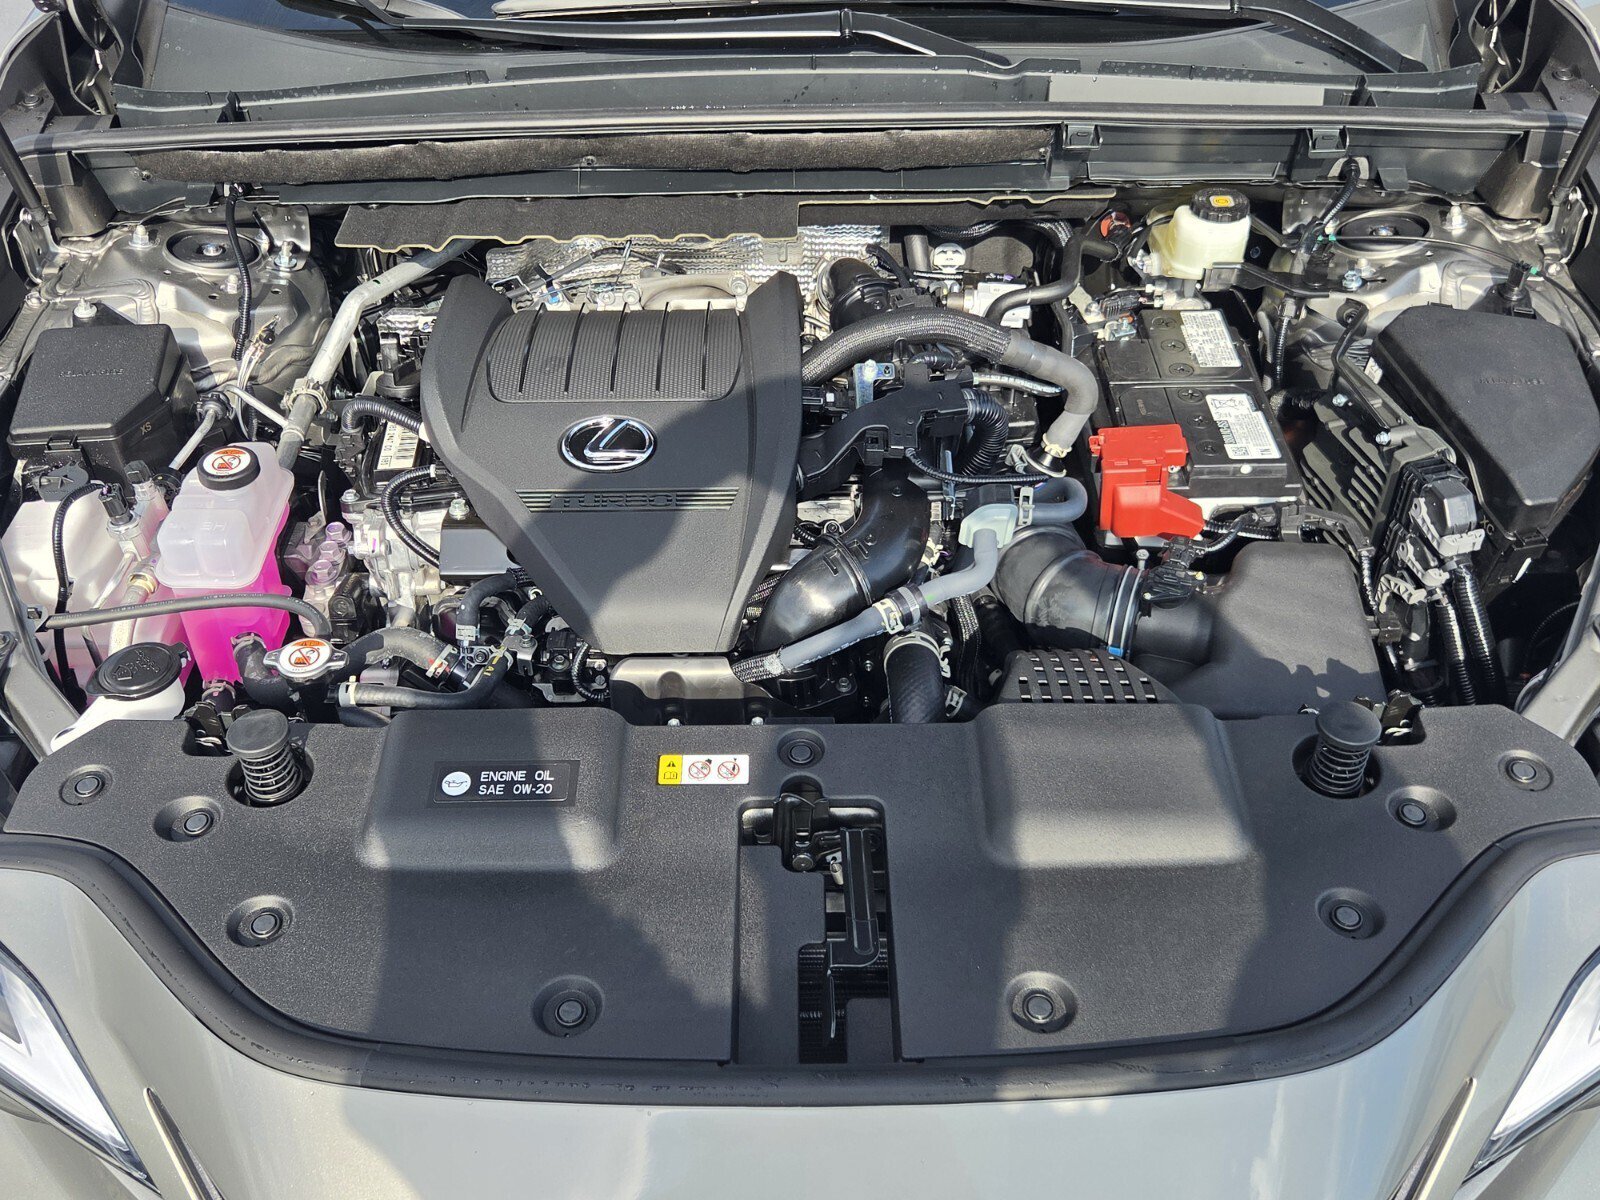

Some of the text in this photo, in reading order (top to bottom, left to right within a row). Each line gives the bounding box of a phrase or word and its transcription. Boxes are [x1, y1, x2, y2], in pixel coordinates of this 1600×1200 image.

[553, 493, 673, 508] TURBO
[480, 770, 554, 782] ENGINE OIL
[478, 783, 553, 795] SAE 0W-20
